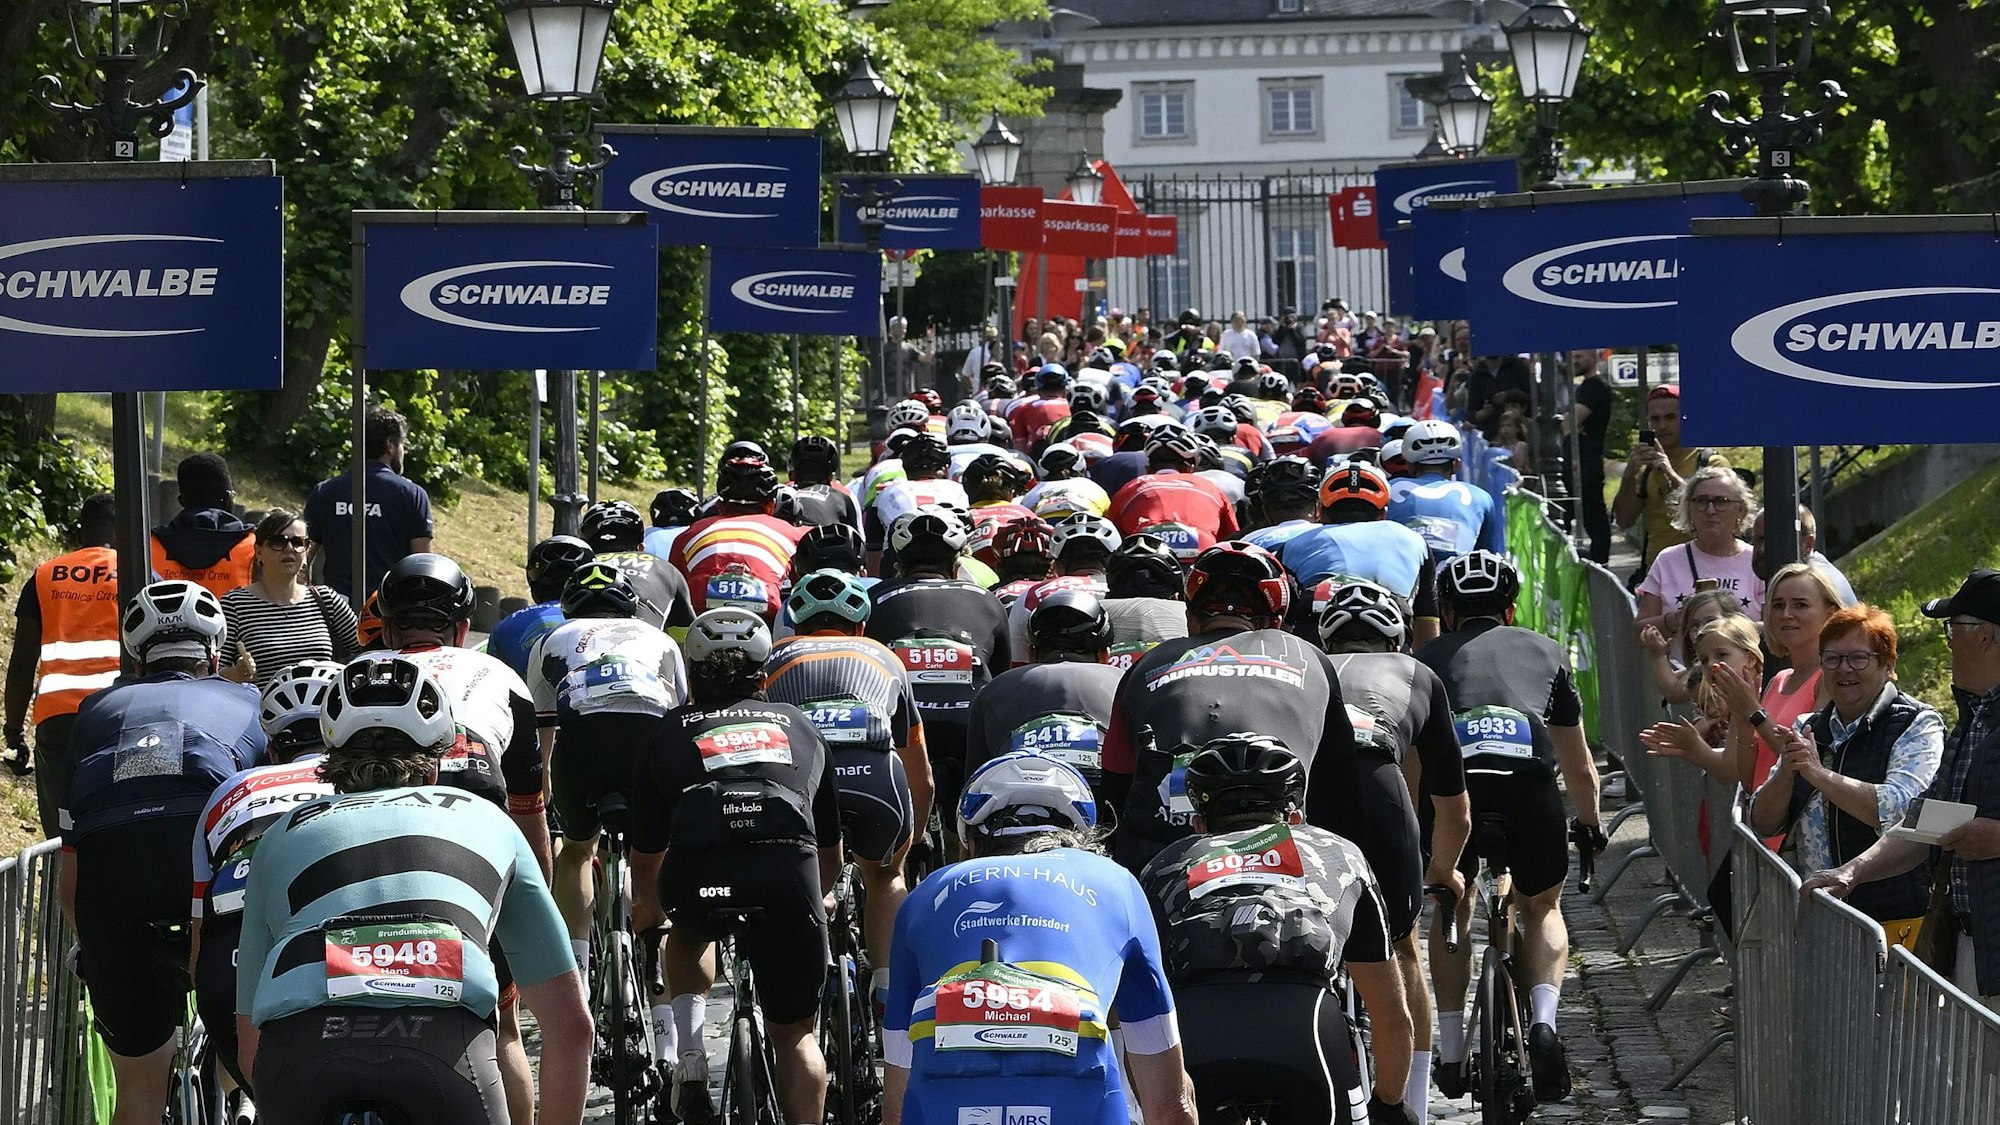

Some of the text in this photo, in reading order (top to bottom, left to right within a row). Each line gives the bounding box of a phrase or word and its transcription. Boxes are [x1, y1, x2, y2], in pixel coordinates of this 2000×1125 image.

[119, 143, 130, 157] 2
[1776, 153, 1785, 165] 3
[658, 180, 787, 198] SCHWALBE
[877, 207, 960, 218] SCHWALBE
[1540, 258, 1678, 287] SCHWAL
[0, 267, 219, 299] CHWALBE
[752, 282, 855, 299] SCHWALBE
[437, 284, 611, 305] SCHWALBE
[51, 589, 95, 603] Technical
[909, 648, 959, 664] 5156
[1146, 664, 1304, 693] TAUNUSTALER
[1466, 716, 1518, 736] 5933
[712, 730, 771, 747] 5964
[734, 743, 757, 752] David
[1078, 754, 1092, 762] 125
[285, 791, 472, 833] BEAT
[730, 818, 756, 829] GORE
[1206, 849, 1282, 874] 5020
[699, 886, 732, 898] GORE
[953, 865, 1099, 908] KERN-HAUS
[960, 913, 1071, 933] Stadtwerke Troisdorf
[351, 940, 438, 967] 5948
[380, 967, 410, 976] Hans
[433, 984, 454, 997] 125
[962, 980, 1054, 1012] 5954
[984, 1010, 1031, 1022] Michael
[320, 1015, 434, 1040] BEAT
[1047, 1033, 1069, 1047] 125
